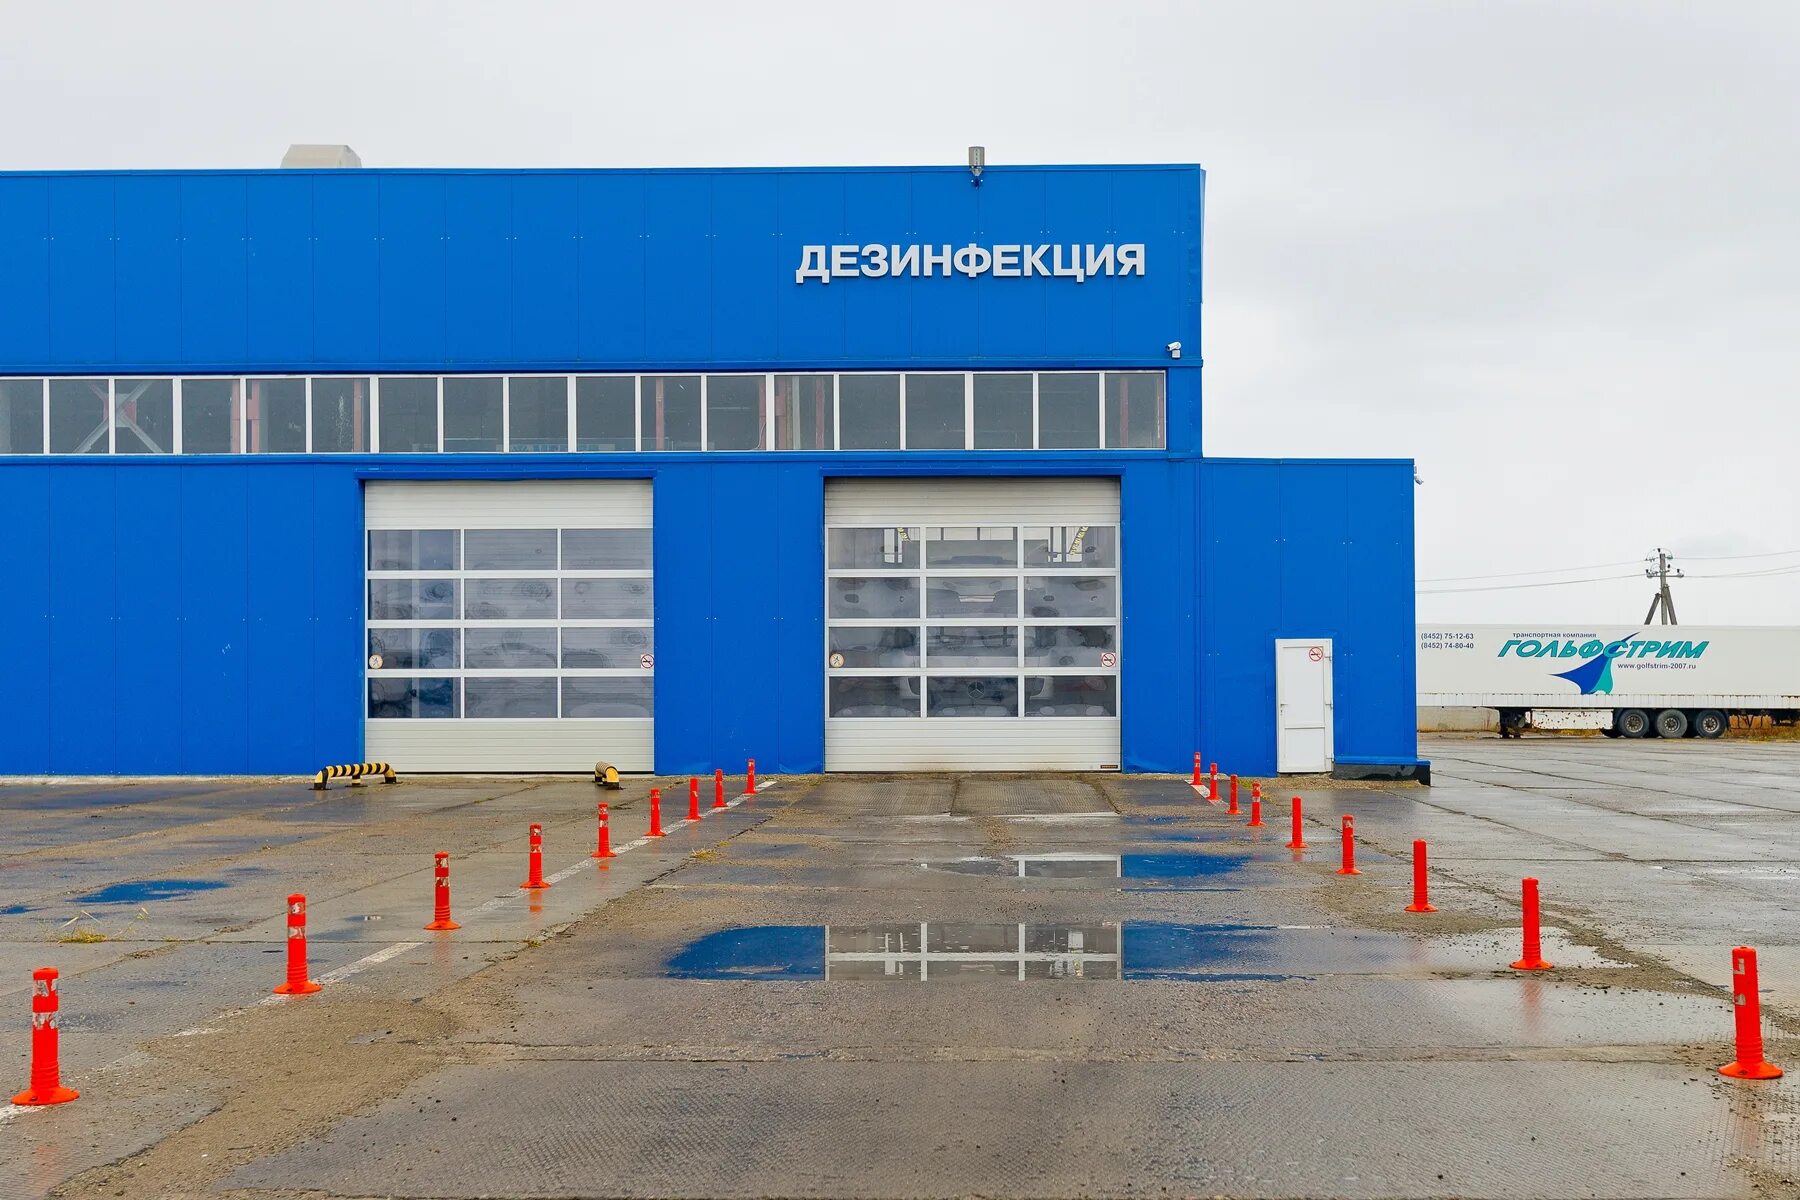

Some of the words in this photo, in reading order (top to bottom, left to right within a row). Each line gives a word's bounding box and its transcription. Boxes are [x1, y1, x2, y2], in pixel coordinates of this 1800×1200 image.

[796, 243, 1146, 284] ДЕЗИНФЕКЦИЯ
[1421, 632, 1443, 641] (8452)
[1444, 632, 1474, 640] 75-12-63
[1421, 642, 1443, 650] (8452)
[1497, 639, 1710, 659] ГОЛЬФСТРИМ
[1617, 662, 1697, 670] www.golfstrim-2007.ru
